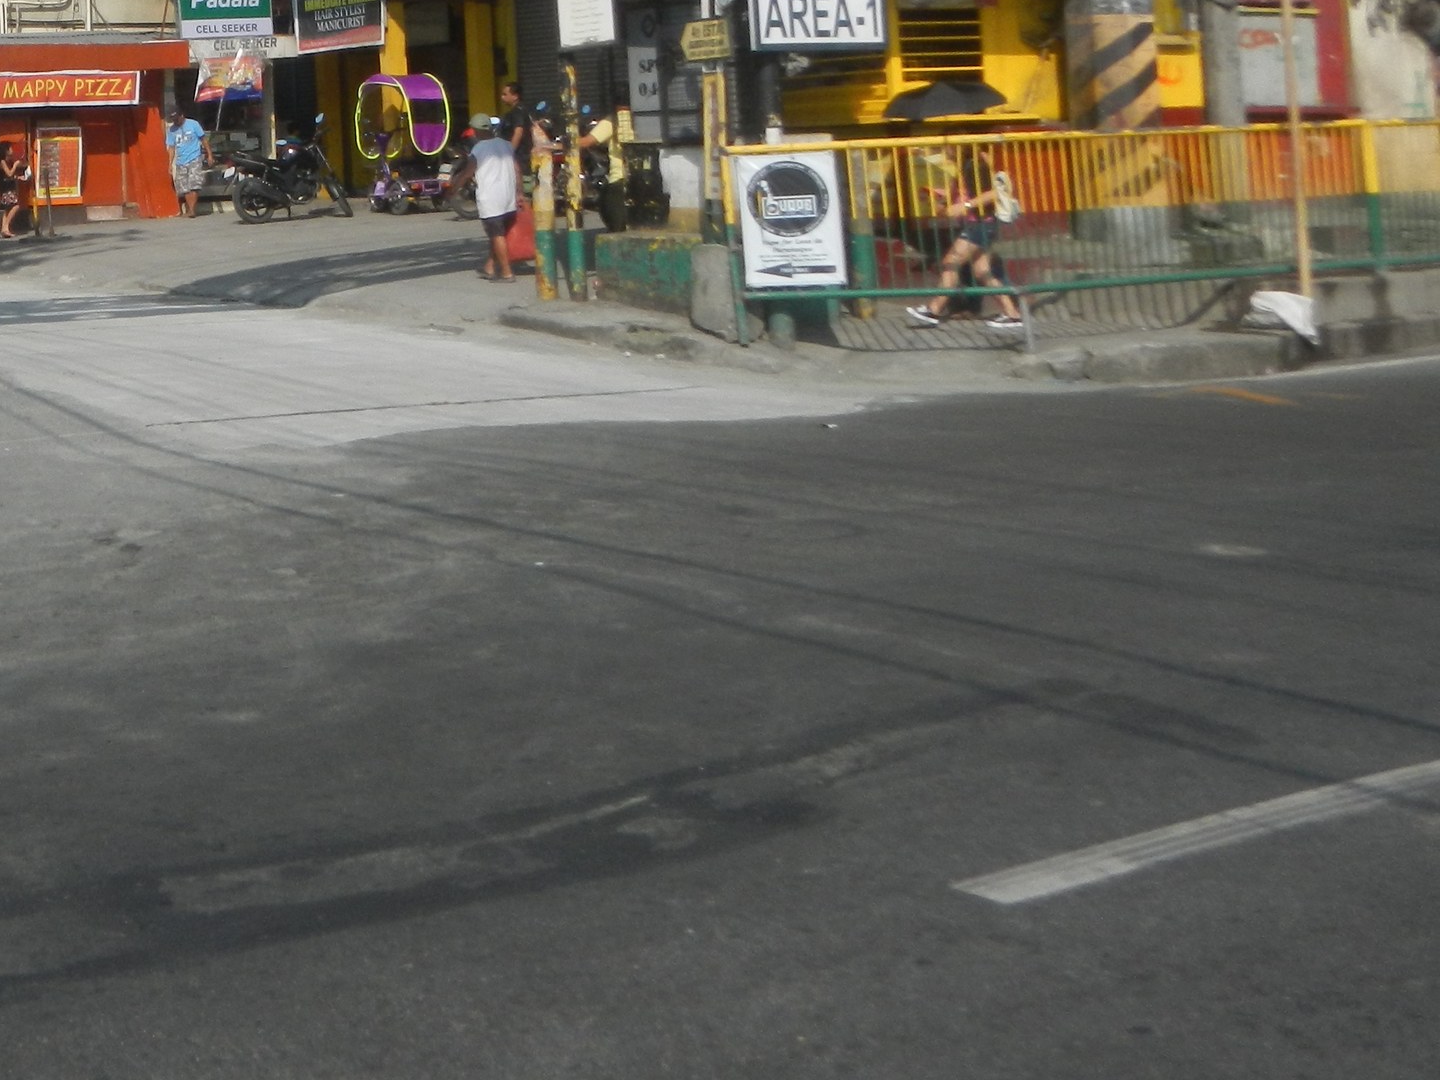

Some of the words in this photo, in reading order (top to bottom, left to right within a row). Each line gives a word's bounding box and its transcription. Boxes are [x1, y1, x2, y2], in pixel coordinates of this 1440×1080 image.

[314, 8, 333, 21] HAIR
[334, 4, 367, 17] STYLIST
[196, 24, 219, 34] CELL
[221, 23, 258, 33] SEEKER
[316, 15, 365, 33] MANICURIST
[213, 39, 236, 52] CELL
[3, 79, 67, 99] MAPPY
[74, 78, 132, 97] PIZZA
